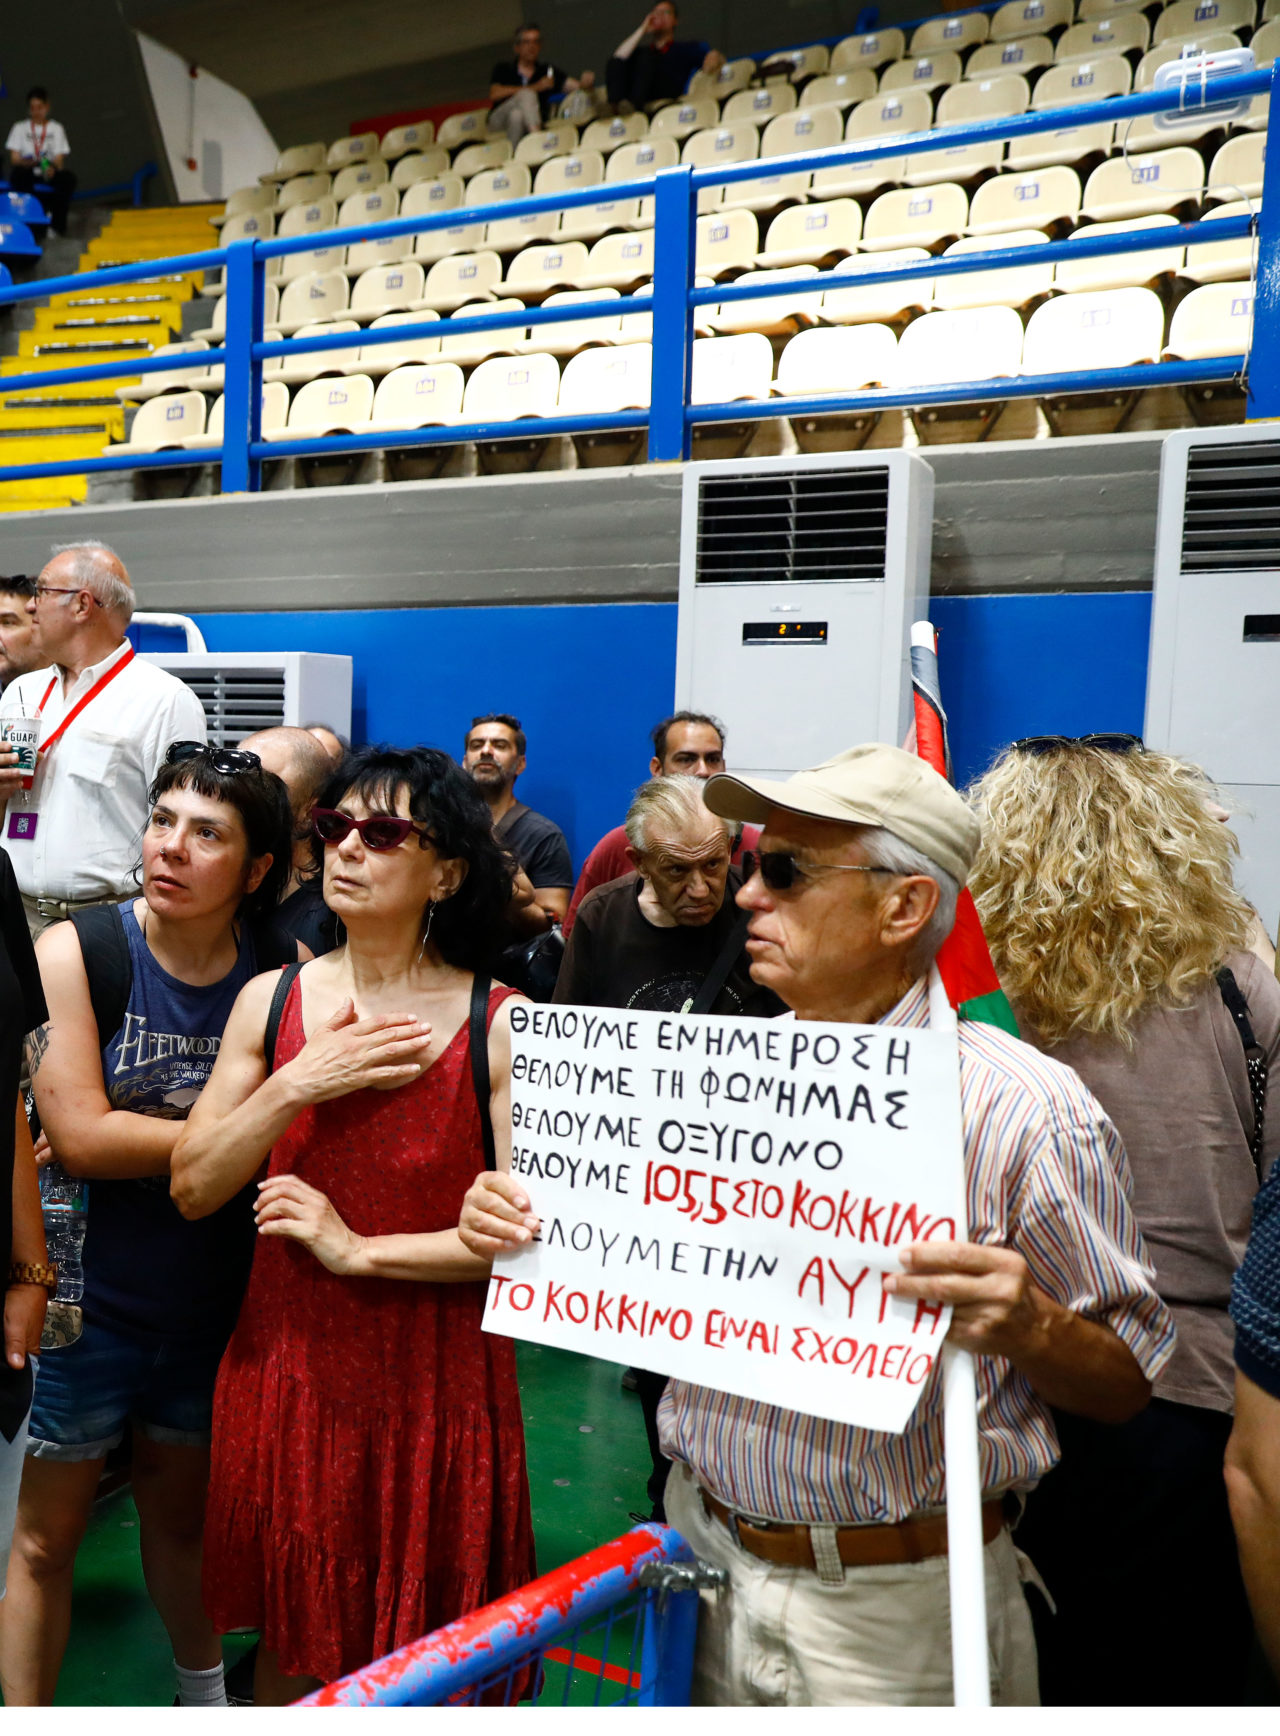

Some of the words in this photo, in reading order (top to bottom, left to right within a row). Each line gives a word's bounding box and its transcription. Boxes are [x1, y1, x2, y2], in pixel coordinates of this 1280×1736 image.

[10, 732, 38, 743] GUAPO
[113, 1012, 221, 1075] FLEETWOOD
[509, 1006, 639, 1051] ΘΕΛΟΥΜΕ
[657, 1020, 910, 1076] ΕΝΗΜΕΡΟΣΗ
[180, 1071, 205, 1081] WALKED
[511, 1053, 636, 1098] ΘΕΛΟΥΜΕ
[651, 1068, 684, 1100] ΤΗ
[511, 1101, 642, 1147] ΘΕΛΟΥΜΕ
[657, 1119, 844, 1170] ΟΞΥΓΟΝΟ
[511, 1146, 632, 1194] ΘΕΛΟΥΜΕ
[490, 1274, 535, 1311] ΤΟ
[543, 1280, 693, 1341] ΚΟΚΚΙΝΟ
[791, 1326, 933, 1385] ΣΧΟΛΕΙΟ
